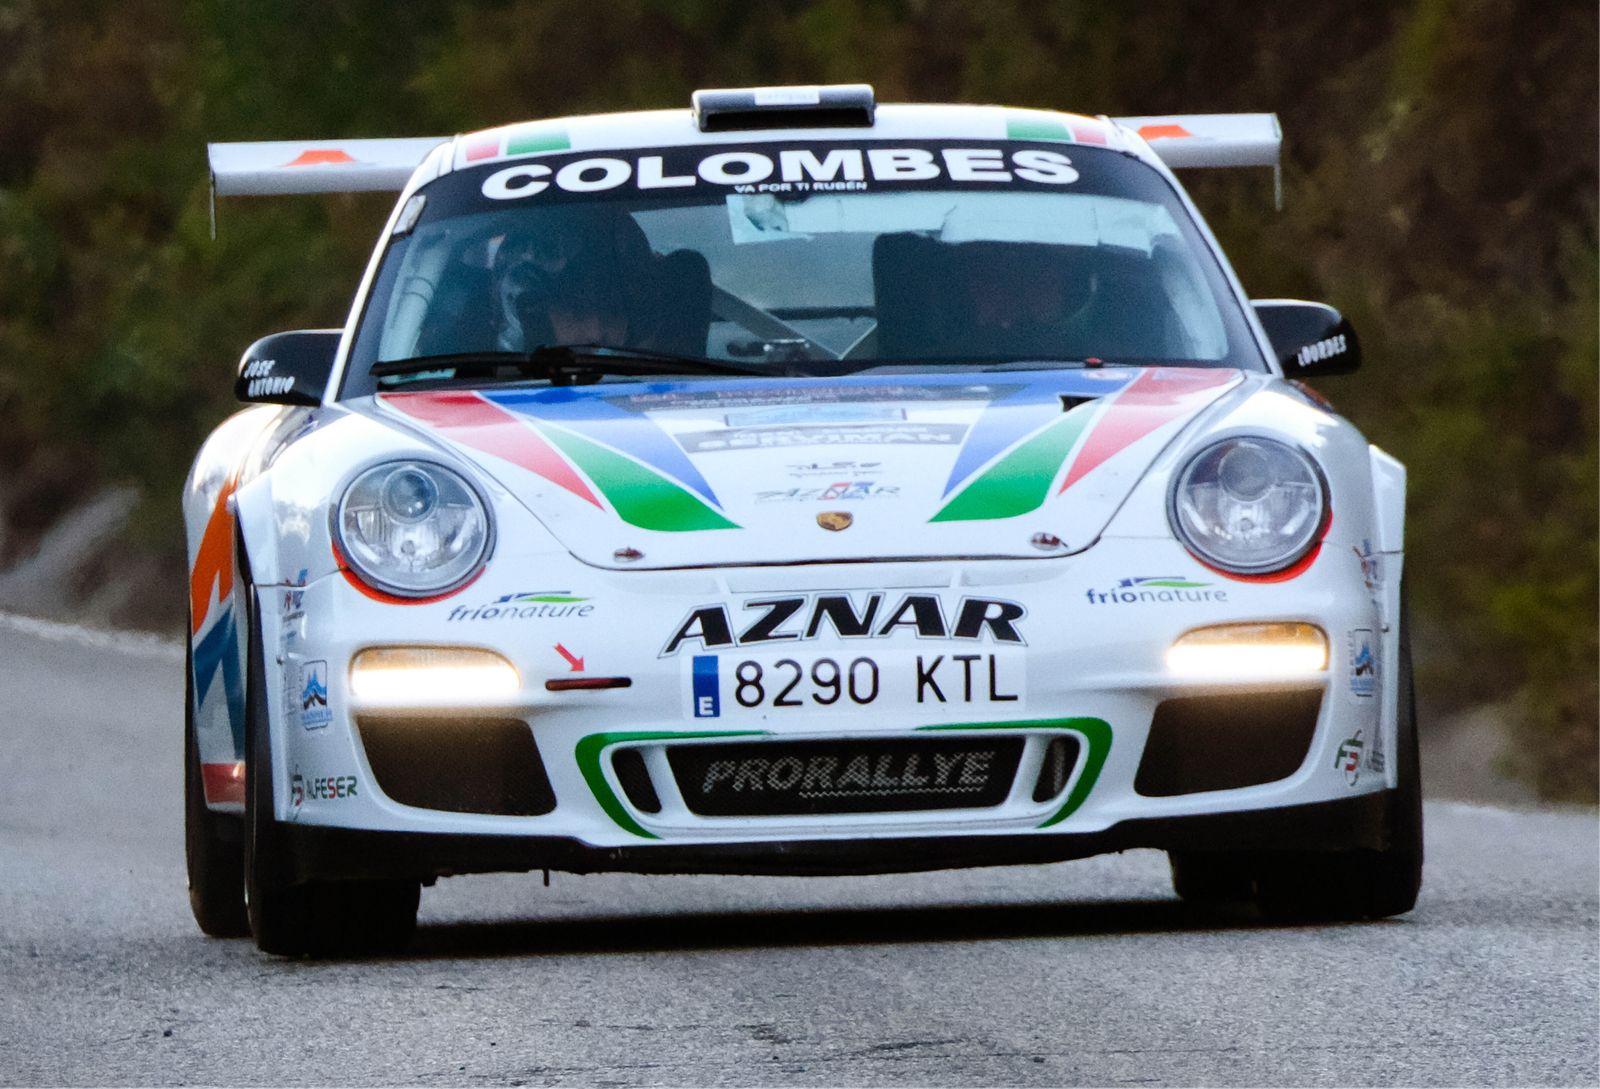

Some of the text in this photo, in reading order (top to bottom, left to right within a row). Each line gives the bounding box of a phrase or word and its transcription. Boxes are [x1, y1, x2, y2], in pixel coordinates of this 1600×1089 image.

[481, 148, 1080, 199] COLOMBES
[734, 184, 756, 194] VA
[758, 182, 792, 193] POR
[795, 181, 810, 192] TI
[243, 359, 275, 379] JOSE
[248, 376, 295, 398] ANTONIO
[1086, 588, 1229, 604] frionature
[447, 603, 595, 622] frionature
[658, 591, 1028, 658] AZNAR
[698, 654, 1019, 716] E 8290 KTL
[702, 751, 996, 794] PRORALLYE
